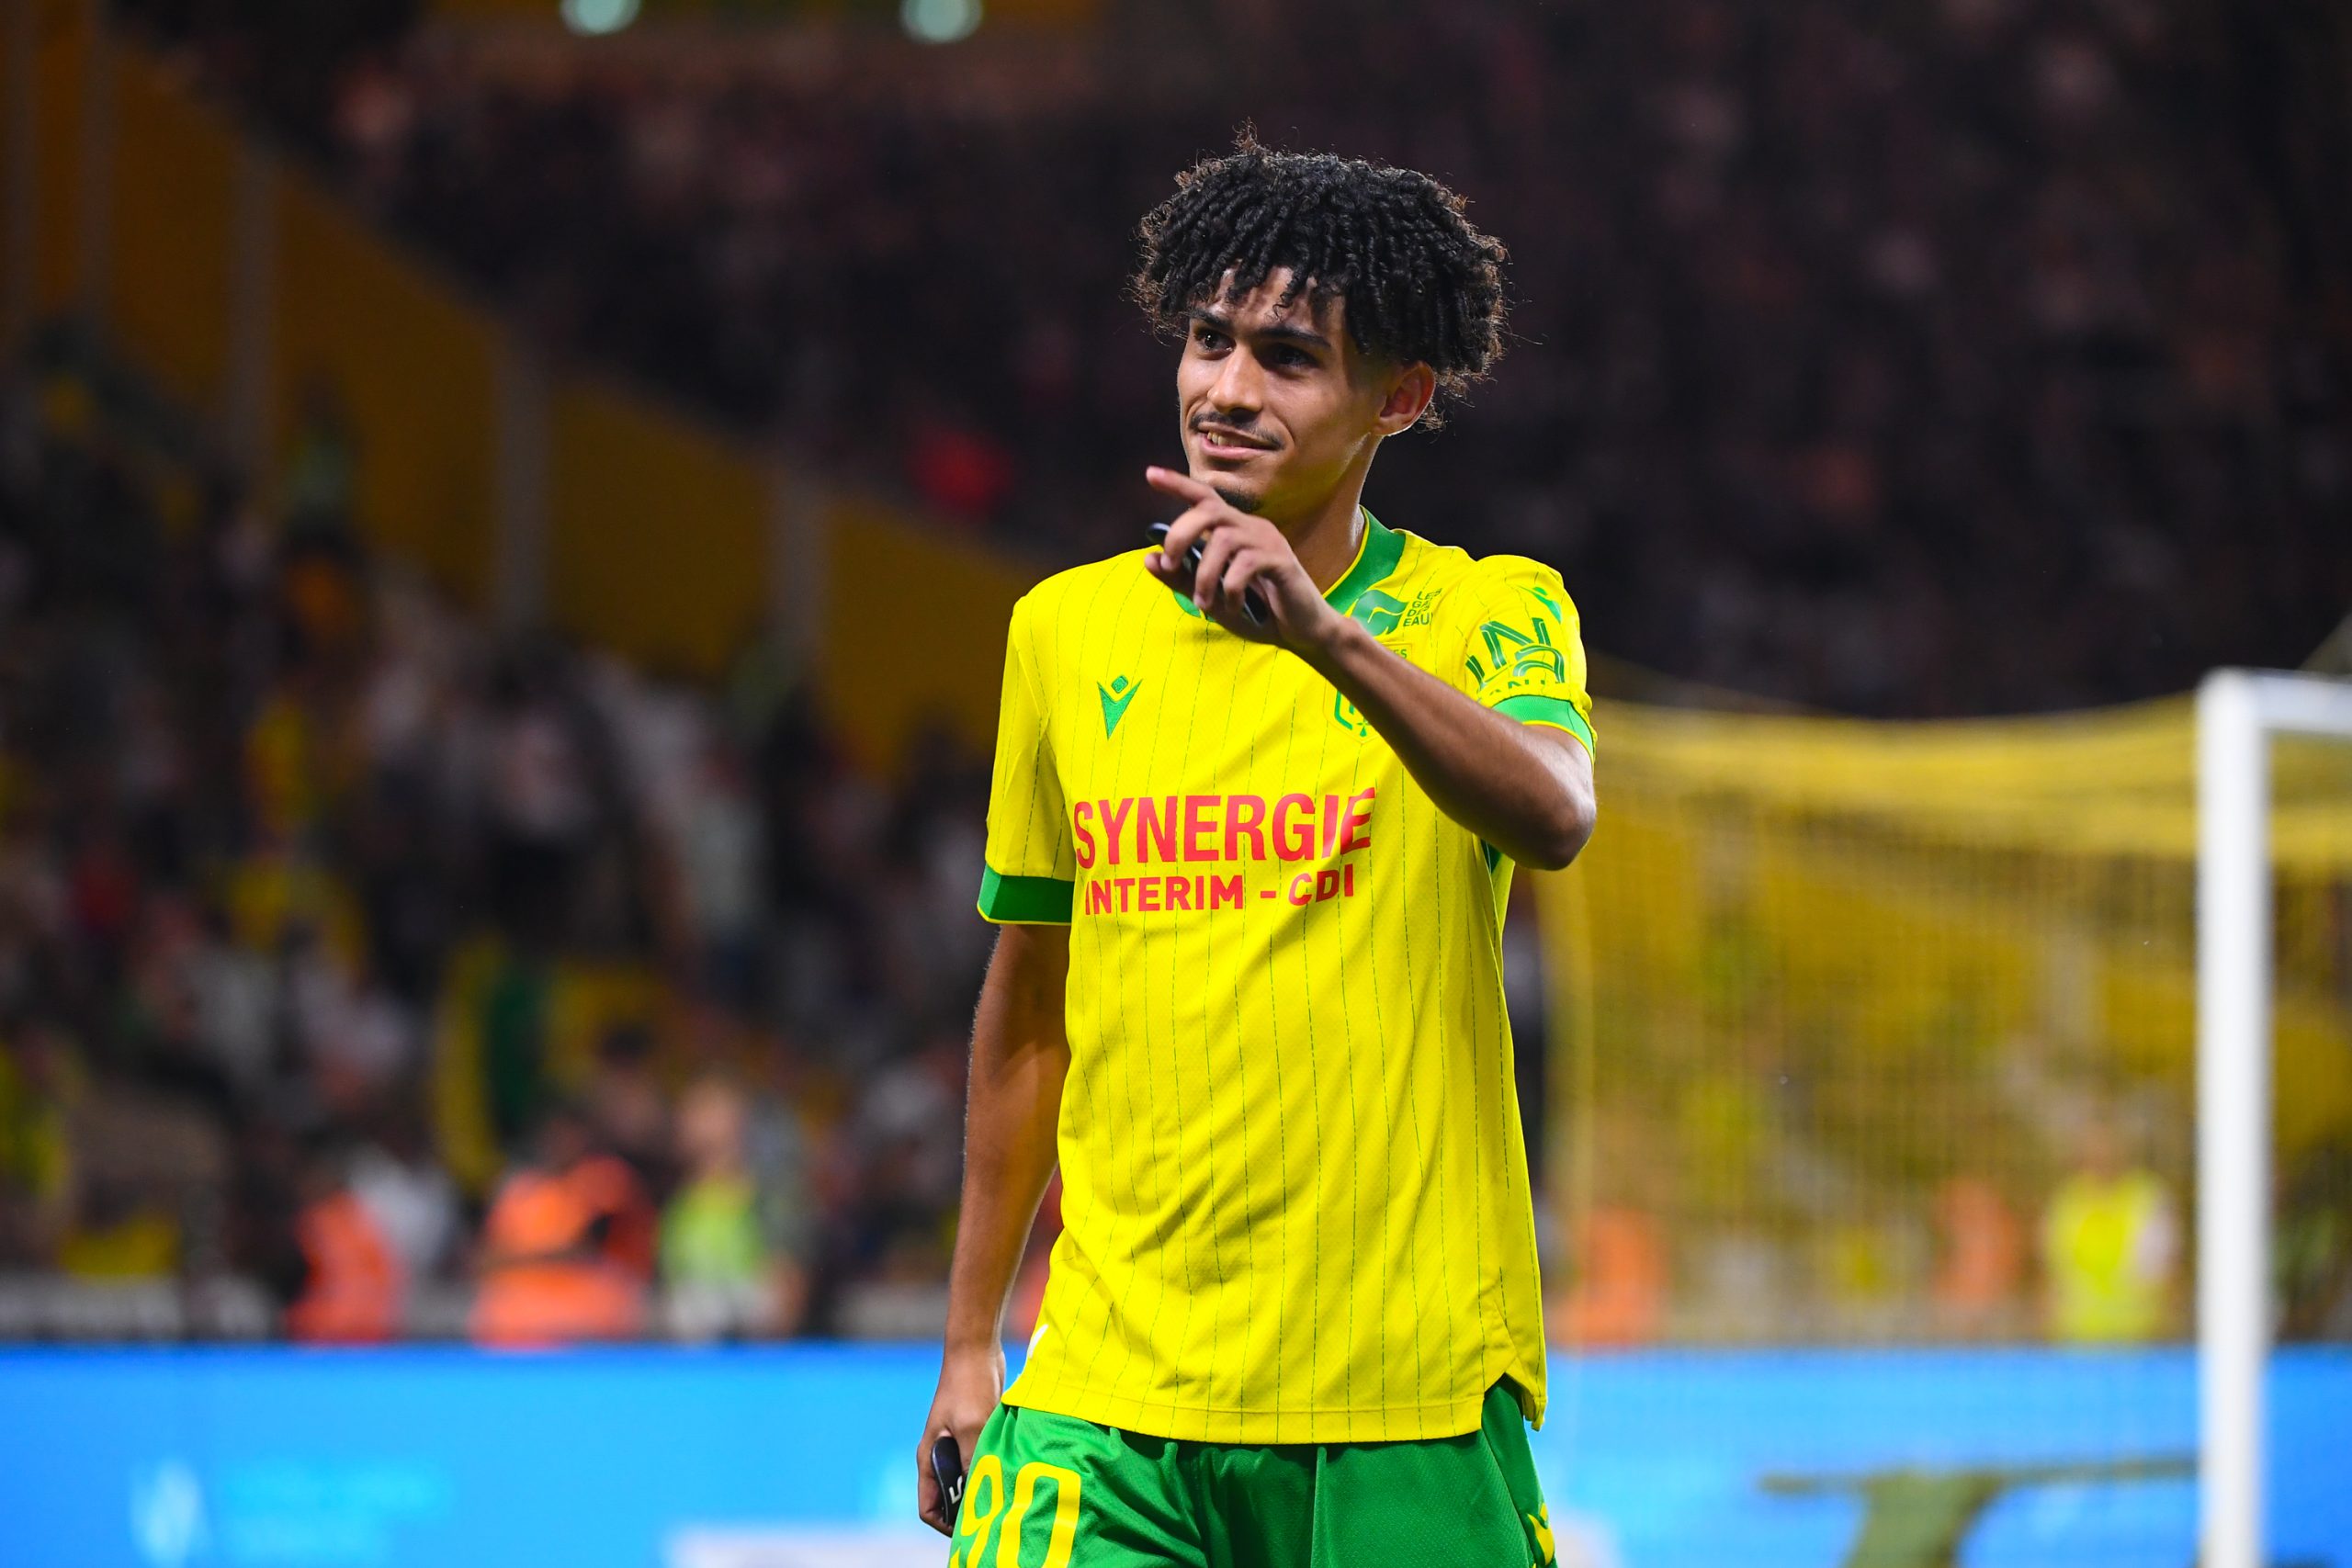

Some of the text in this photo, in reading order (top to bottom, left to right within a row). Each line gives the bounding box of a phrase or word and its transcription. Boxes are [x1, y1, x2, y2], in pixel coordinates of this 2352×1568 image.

[1403, 613, 1433, 626] EAU
[1074, 787, 1375, 868] SYNERGIE
[1085, 874, 1243, 915] INTERIM
[1288, 863, 1354, 907] CDI
[948, 1454, 1081, 1568] 90
